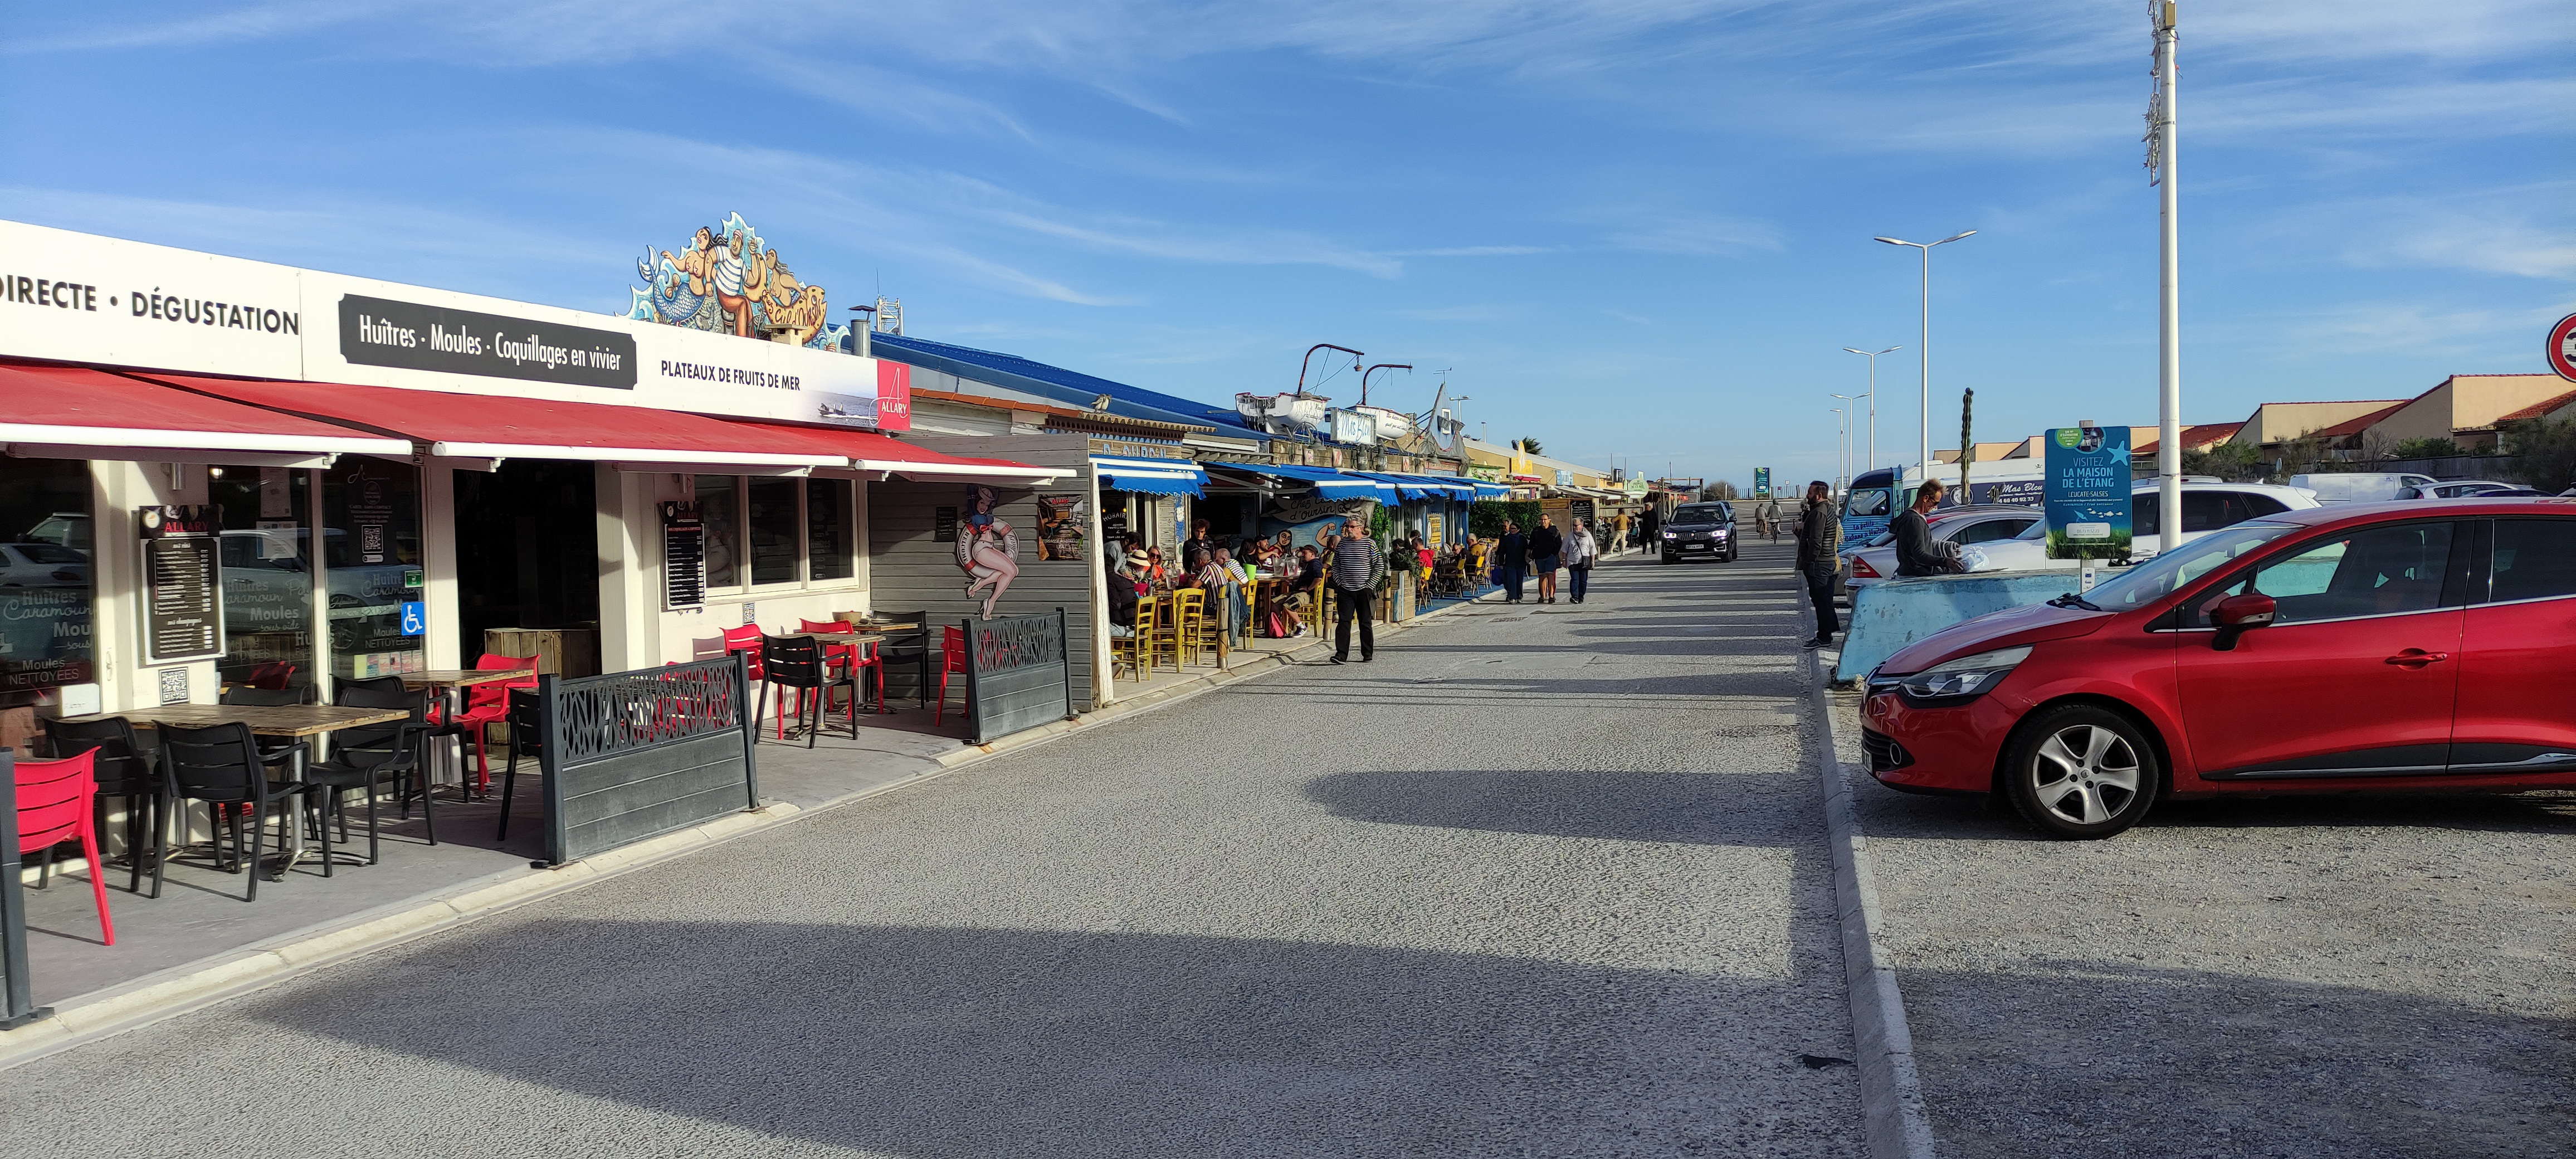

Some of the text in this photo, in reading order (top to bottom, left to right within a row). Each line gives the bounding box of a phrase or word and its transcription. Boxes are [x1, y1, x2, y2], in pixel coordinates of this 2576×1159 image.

[0, 275, 299, 335] IRECTE DÉGUSTATION
[359, 314, 621, 371] Huîtres Moules Coquillages en vivier
[662, 360, 801, 391] PLATEAUX DE FRUITS DE MER
[881, 401, 908, 414] ALLARY
[2073, 457, 2104, 467] VISITEZ
[2063, 467, 2113, 478] LA MAISON
[2002, 484, 2022, 493] Mas
[2024, 483, 2043, 491] Bleu
[2062, 476, 2114, 488] DE L'ÉTANG
[1291, 498, 1311, 510] Chez
[165, 522, 209, 532] ALLARY
[960, 532, 970, 563] WELCOME
[250, 605, 299, 621] Moules
[53, 621, 92, 637] Mou
[23, 658, 66, 671] Moules
[9, 668, 79, 685] NETTOYEES
